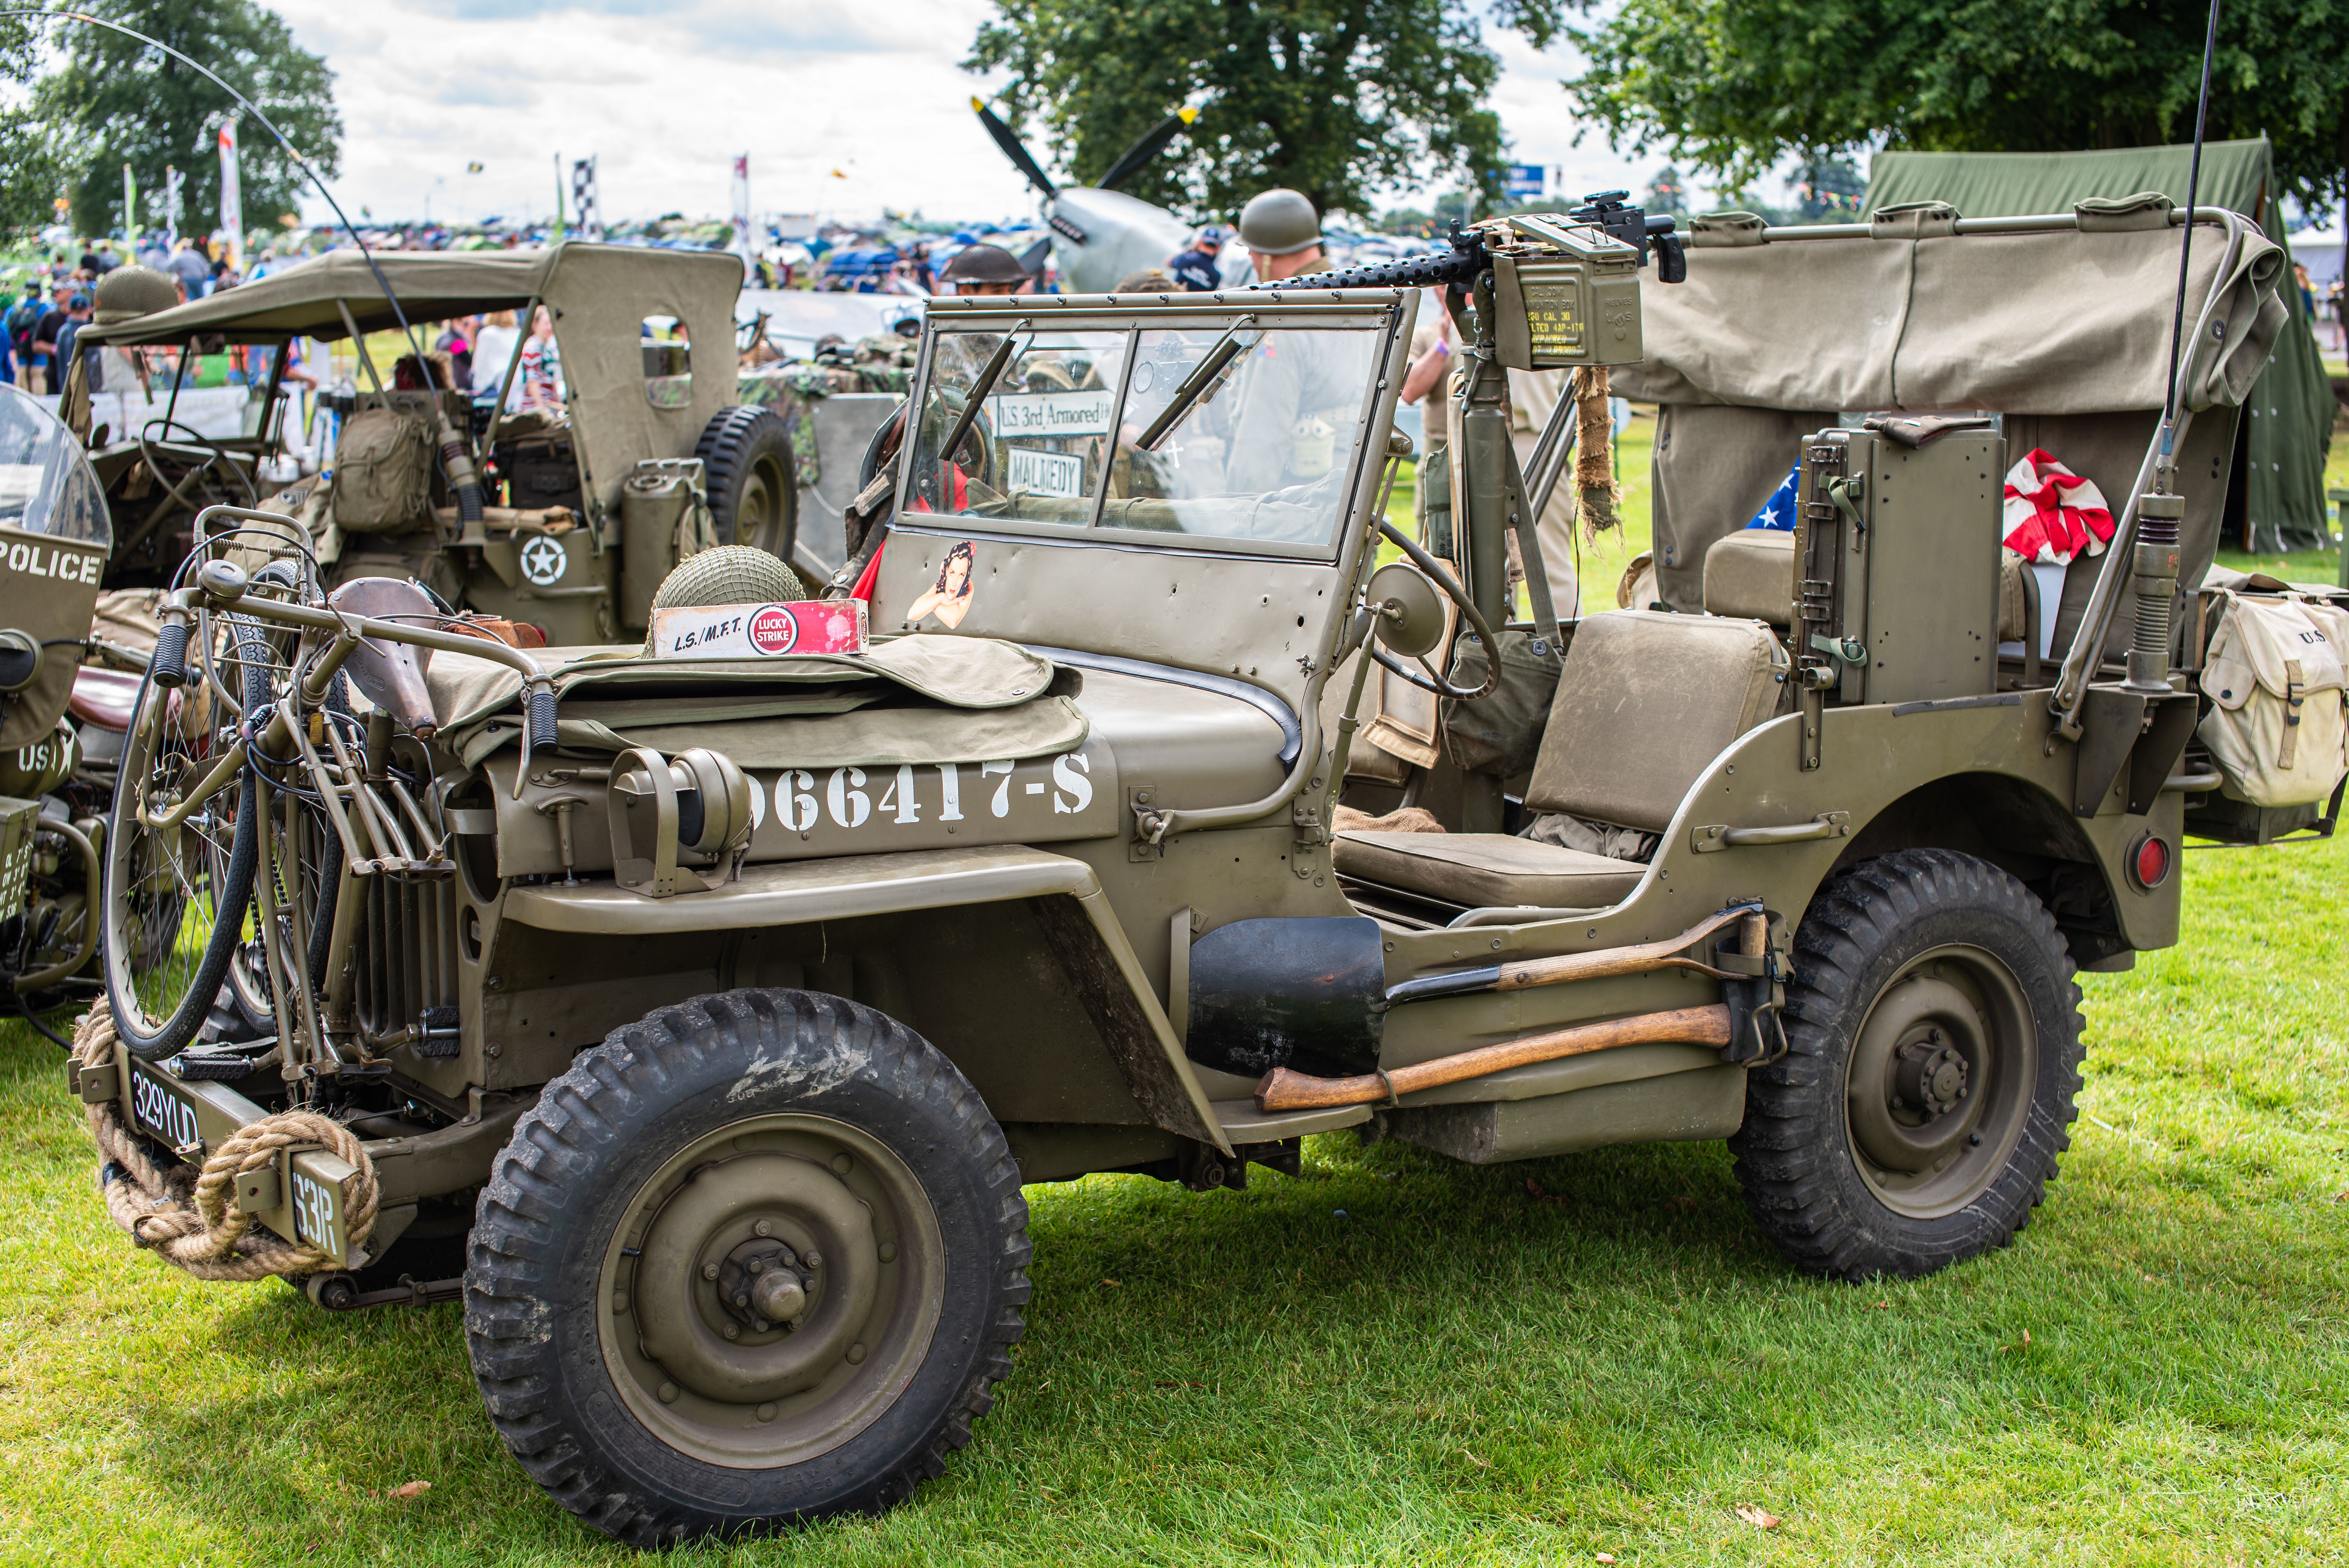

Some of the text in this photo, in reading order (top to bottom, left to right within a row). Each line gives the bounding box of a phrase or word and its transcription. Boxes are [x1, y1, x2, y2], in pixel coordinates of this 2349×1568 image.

[1524, 299, 1575, 310] MMUNITION BOX
[1606, 297, 1632, 306] REEVES
[1527, 312, 1540, 321] 250
[1529, 323, 1549, 332] LTED
[1022, 404, 1043, 427] 3rd
[1047, 402, 1100, 424] Armored
[1012, 456, 1076, 494] MALMEDY
[759, 618, 788, 630] LUCKY
[674, 617, 741, 652] L.S./M.F.T.
[757, 630, 790, 642] STRIKE
[133, 1071, 199, 1146] 329YUD
